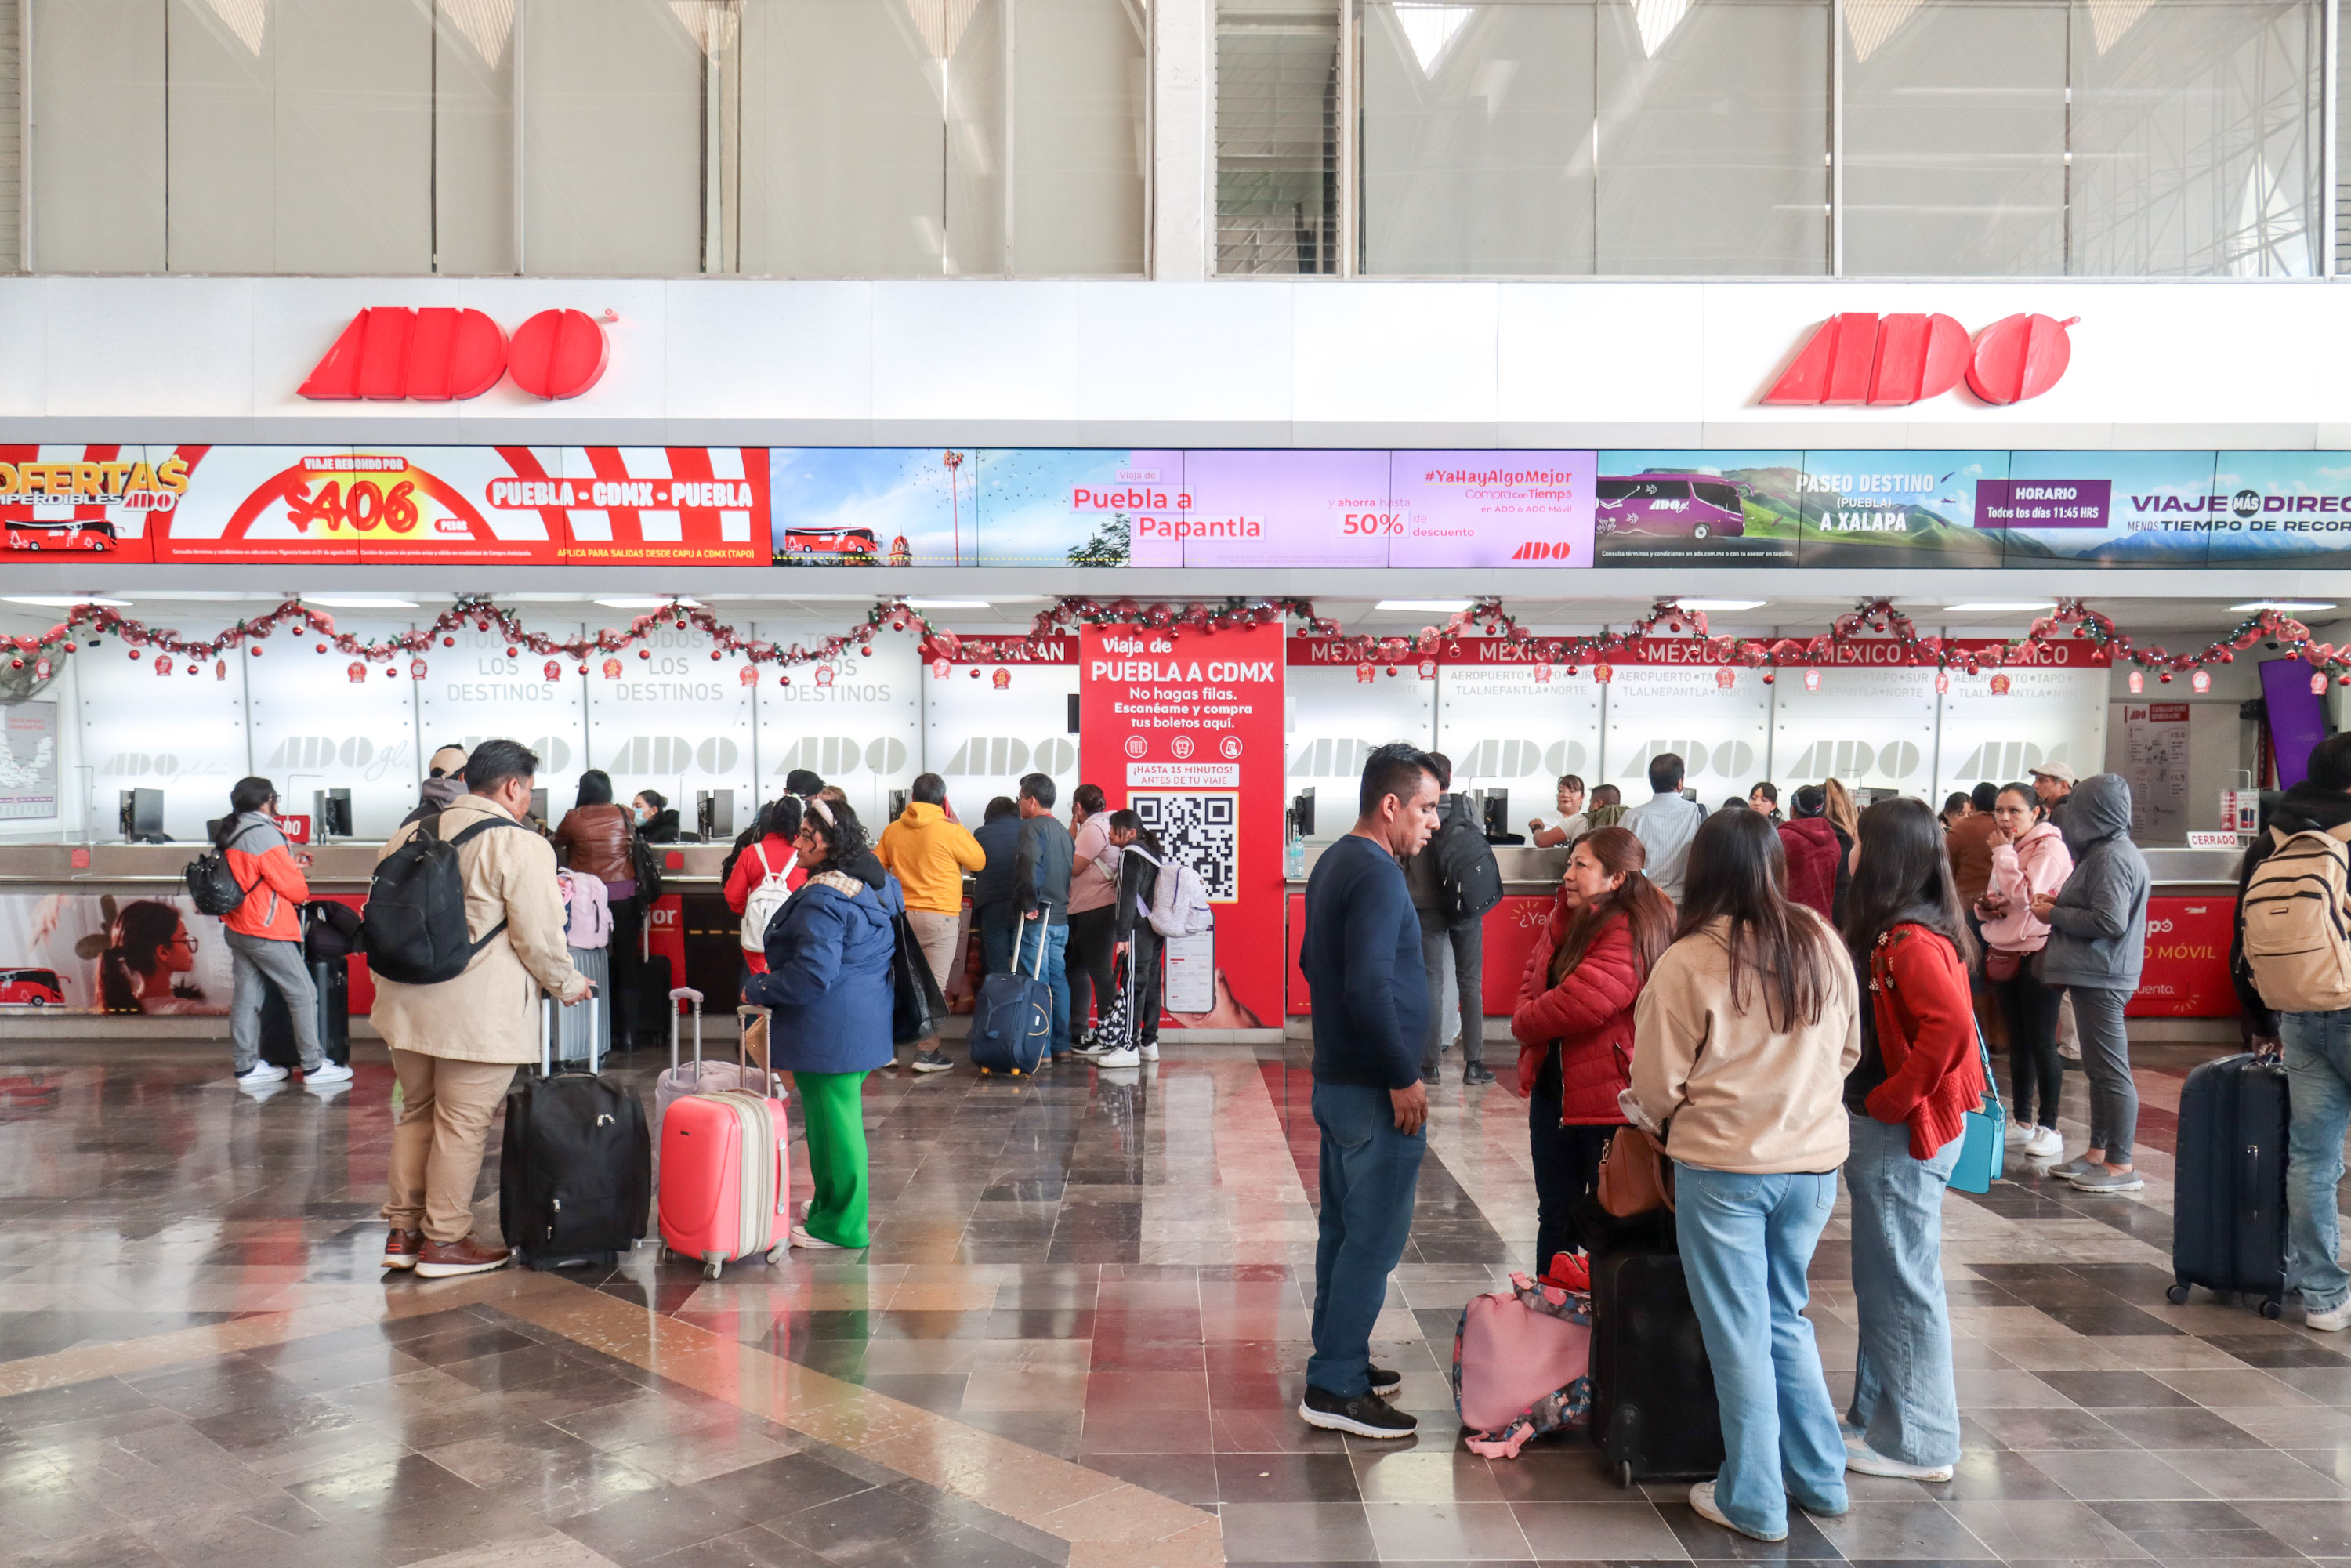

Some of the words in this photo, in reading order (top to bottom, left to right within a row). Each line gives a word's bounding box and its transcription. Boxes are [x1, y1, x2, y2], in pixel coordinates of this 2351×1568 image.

[296, 306, 610, 400] ADO
[1758, 312, 2071, 405] ADO
[304, 457, 335, 472] VIAJE
[336, 458, 382, 472] REDONDO
[384, 458, 404, 472] POR
[1120, 471, 1141, 480] Viaja
[1144, 471, 1156, 480] de
[1425, 469, 1573, 487] #YaHayAlgoMejor
[1795, 474, 1853, 493] PASEO
[1859, 474, 1935, 493] DESTINO
[0, 493, 122, 505] PERDIBLES
[121, 491, 176, 512] ADO
[492, 482, 575, 507] PUEBLA
[592, 483, 654, 507] CDMX
[672, 483, 753, 508] PUEBLA
[1074, 488, 1167, 509] Puebla
[1177, 494, 1193, 509] a
[1465, 489, 1511, 502] Compra
[2015, 487, 2077, 500] HORARIO
[284, 480, 418, 534] $406
[1328, 499, 1335, 509] y
[1338, 498, 1376, 508] ahorra
[1379, 498, 1411, 508] hasta
[1549, 505, 1572, 513] Móvil
[1649, 499, 1681, 510] ADO
[1837, 497, 1892, 509] (PUEBLA)
[2131, 496, 2228, 512] VIAJE
[2233, 494, 2259, 511] MÁS
[1413, 513, 1427, 523] de
[1987, 507, 2014, 518] Todos
[2016, 508, 2030, 518] los
[2032, 506, 2051, 519] días
[2053, 507, 2078, 519] 11:45
[2080, 508, 2099, 519] HRS
[441, 520, 468, 531] PESOS
[1140, 516, 1262, 541] Papantla
[1342, 513, 1404, 534] 50%
[1820, 512, 1832, 531] A
[1838, 512, 1907, 531] XALAPA
[2128, 521, 2159, 531] MENOS
[2161, 521, 2242, 531] TIEMPO
[2249, 521, 2277, 531] DE
[1413, 527, 1475, 538] descuento
[557, 549, 586, 558] APLICA
[589, 549, 609, 558] PARA
[610, 549, 644, 558] SALIDAS
[704, 550, 726, 559] CDMX
[728, 550, 754, 559] (TAPO)
[1511, 542, 1571, 560] ADO
[1102, 636, 1144, 657] Viaja
[1150, 638, 1172, 653] de
[479, 657, 519, 675] LOS
[649, 657, 689, 675] LOS
[1092, 661, 1182, 682] PUEBLA
[1186, 662, 1203, 682] A
[1208, 662, 1275, 682] CDMX
[1451, 670, 1524, 680] AEROPUERTO
[1618, 672, 1692, 682] AEROPUERTO
[1906, 673, 1929, 683] SUR
[2037, 674, 2066, 683] TAPO
[447, 683, 554, 701] DESTINOS
[617, 683, 723, 701] DESTINOS
[784, 684, 891, 702] DESTINOS
[1129, 687, 1150, 700] No
[1154, 686, 1199, 703] hagas
[1202, 686, 1237, 701] filas.
[1455, 686, 1542, 695] TLALNEPANTLA
[1550, 686, 1587, 695] NORTE
[1623, 686, 1711, 697] TLALNEPANTLA
[1886, 687, 1924, 697] NORTE
[1114, 702, 1189, 714] Escanéame
[1193, 705, 1200, 716] y
[1204, 705, 1252, 716] compra
[1132, 717, 1150, 728] tus
[1154, 717, 1200, 728] boletos
[1203, 716, 1235, 730] aquí.
[266, 737, 374, 768] ADO
[608, 737, 739, 775] ADO
[773, 737, 907, 775] ADO
[942, 737, 1076, 776] ADO
[1452, 739, 1586, 777] ADO
[1786, 740, 1920, 779] ADO
[99, 753, 179, 776] ADO
[1133, 766, 1168, 775] ¡HASTA
[1185, 766, 1233, 774] MINUTOS!
[2192, 835, 2236, 846] CERRADO
[1520, 911, 1547, 928] ¿Ya
[2158, 943, 2217, 959] MÓVIL
